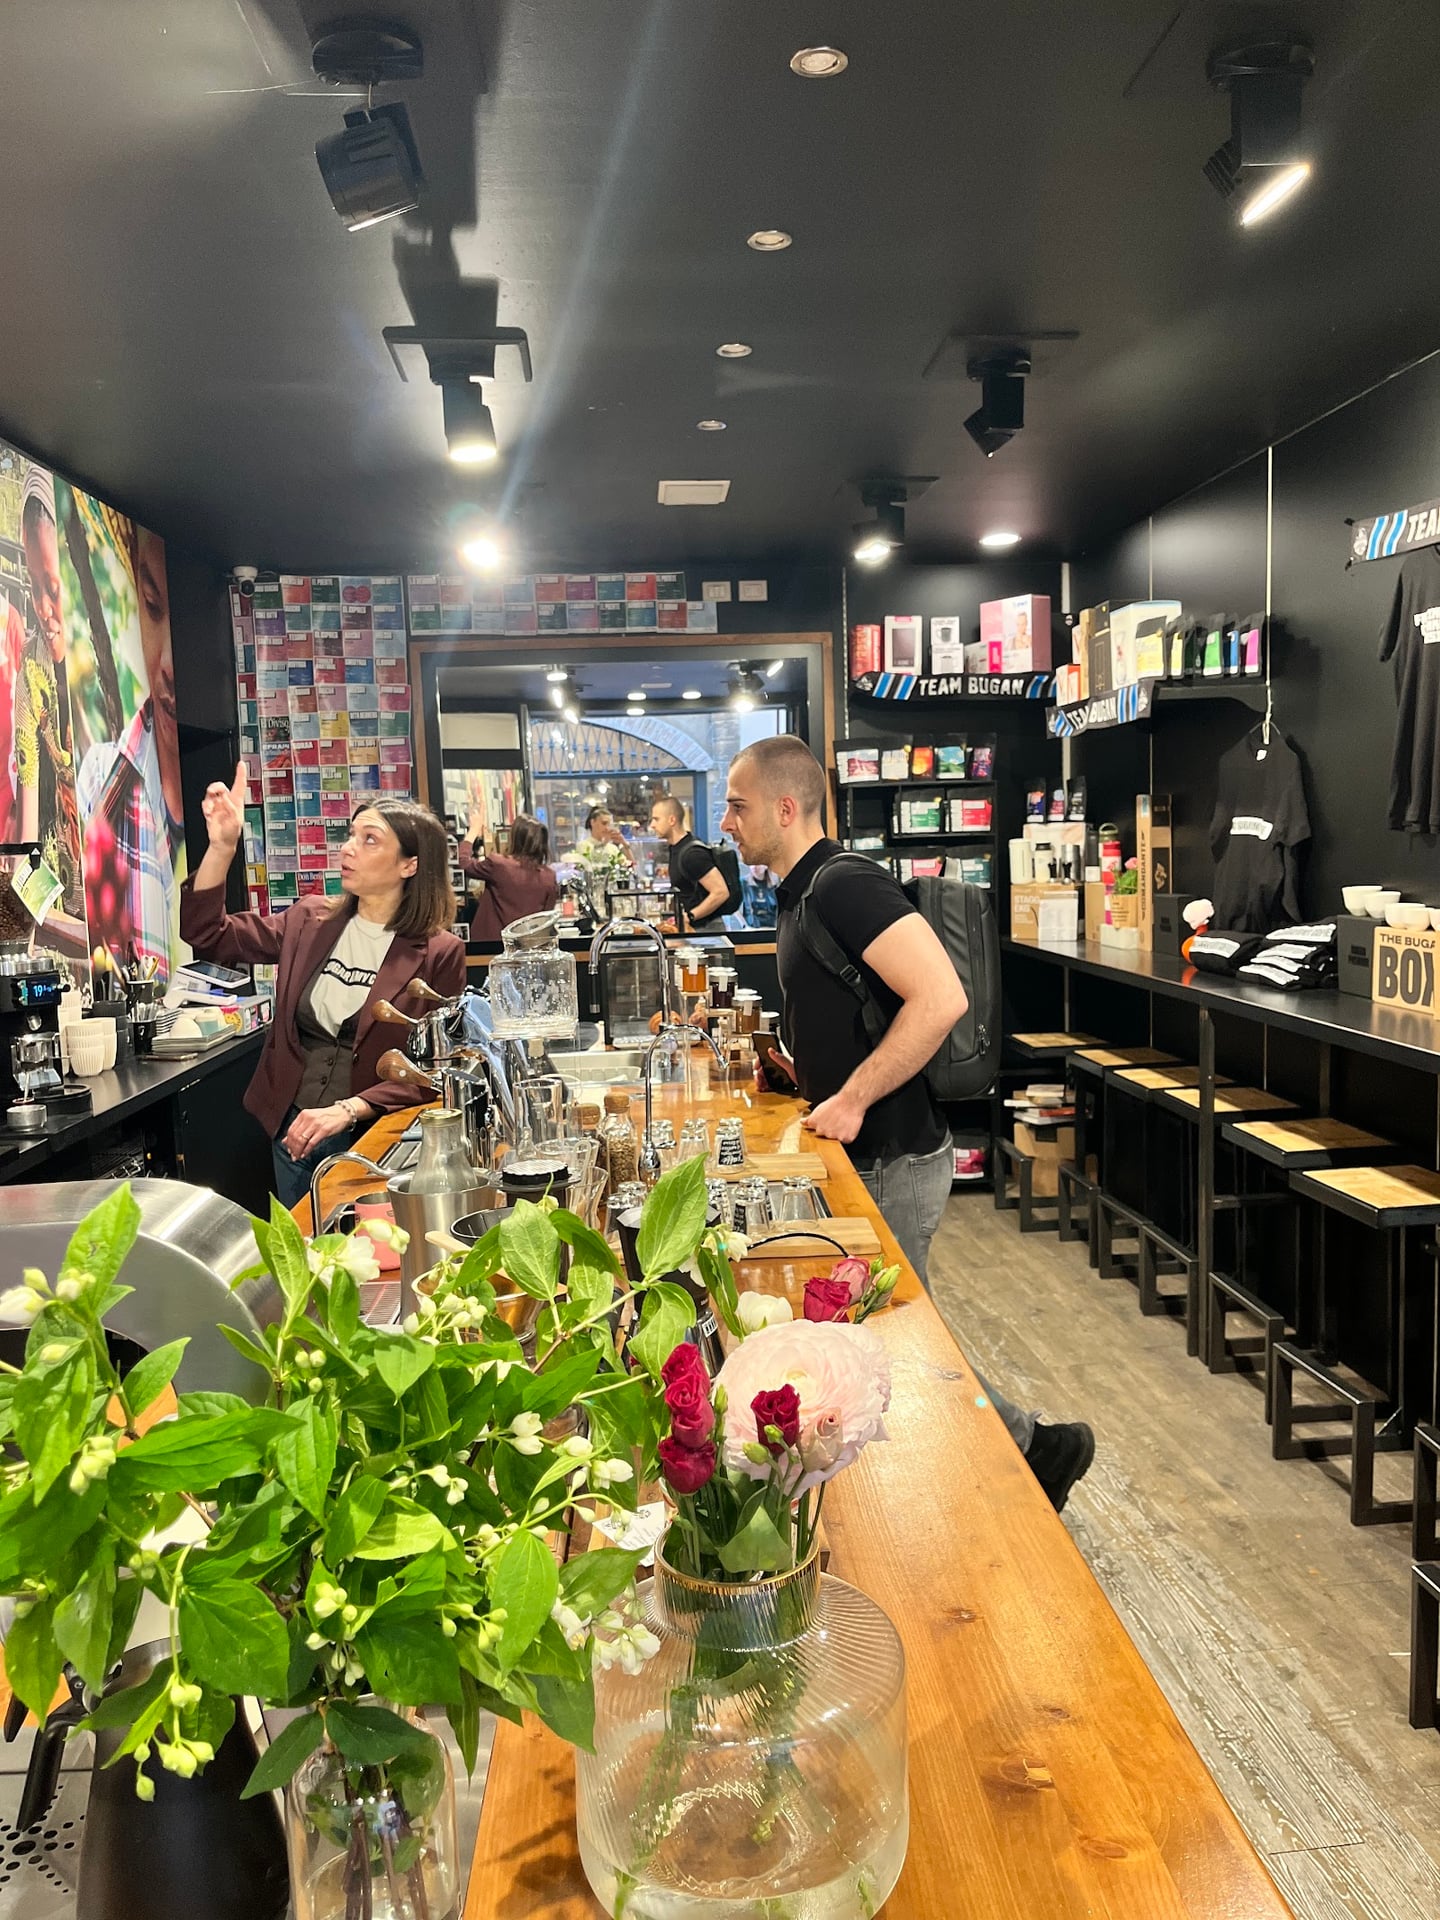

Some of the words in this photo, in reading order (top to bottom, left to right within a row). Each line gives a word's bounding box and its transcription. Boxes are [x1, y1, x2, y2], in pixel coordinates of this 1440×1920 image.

[1407, 508, 1440, 543] TEA
[919, 677, 961, 696] TEAM
[968, 677, 1024, 696] BUGAN
[1380, 933, 1402, 944] THE
[1405, 936, 1436, 949] BUGA
[1378, 945, 1434, 1007] BOX
